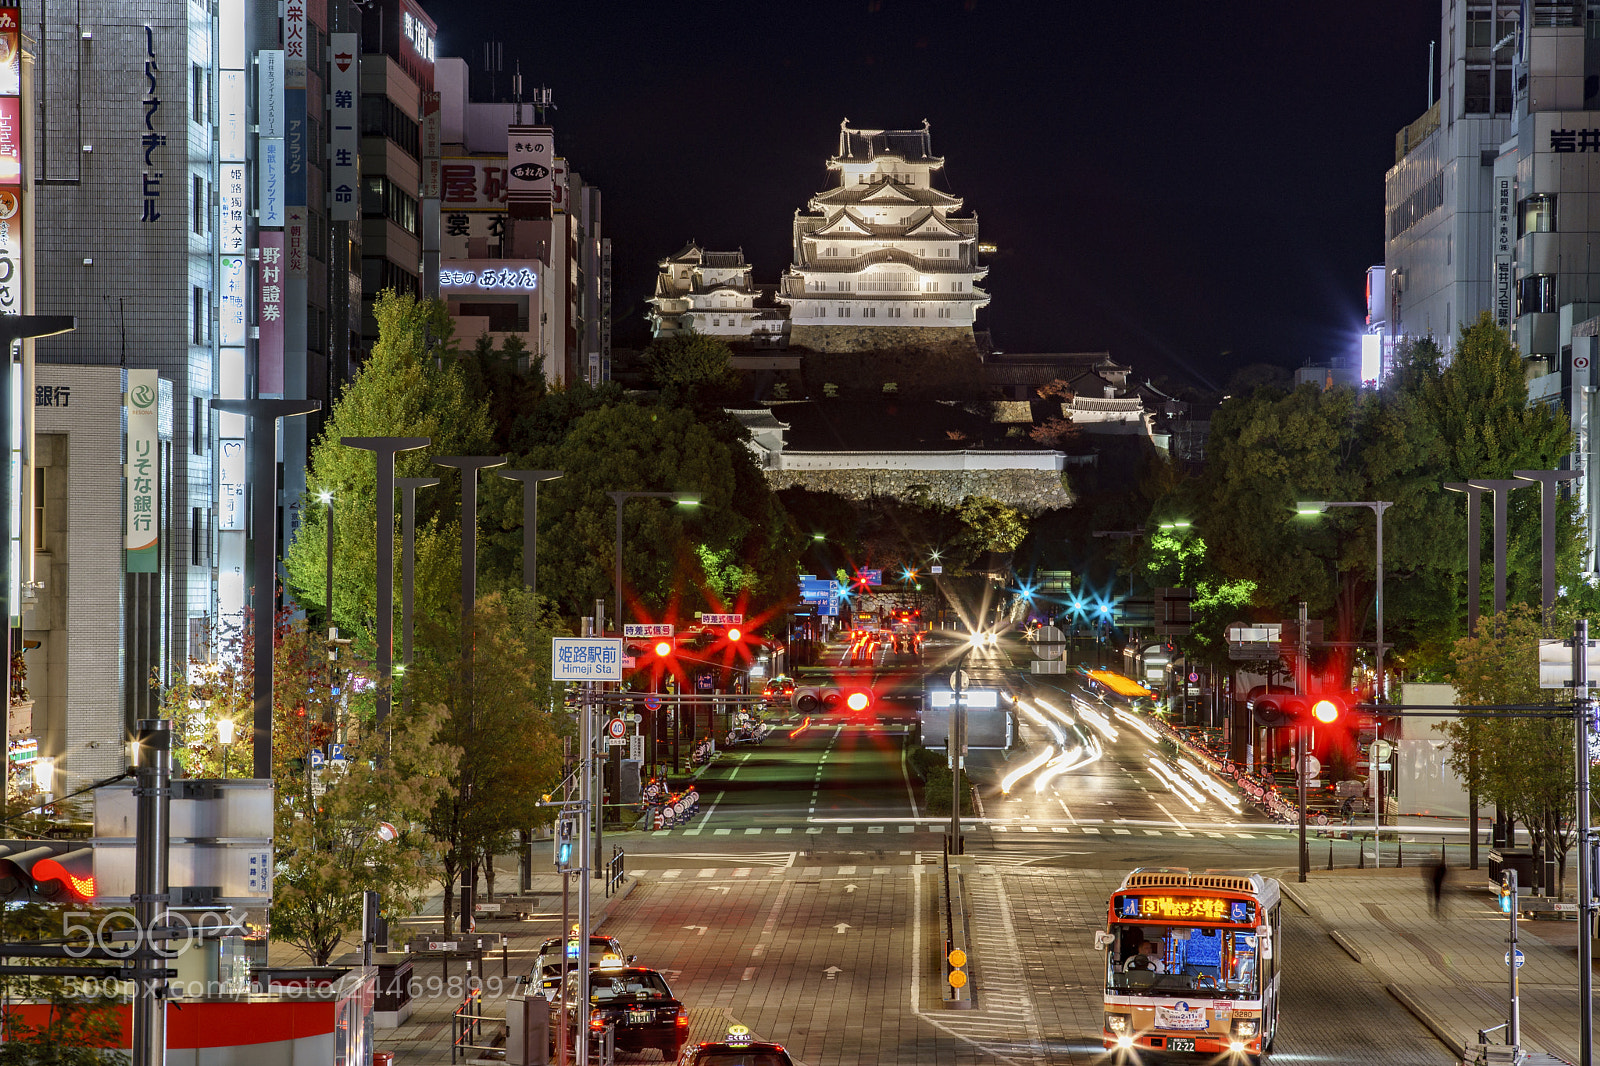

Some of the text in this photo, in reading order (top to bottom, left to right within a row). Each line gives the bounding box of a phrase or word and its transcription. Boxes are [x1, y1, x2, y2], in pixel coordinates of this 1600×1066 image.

[286, 0, 303, 57] 栄火災
[142, 25, 166, 223] しらさぎビル
[289, 119, 301, 174] アフラック
[335, 90, 352, 203] 第一生命
[515, 142, 544, 153] きもの
[1550, 129, 1600, 153] 岩井
[514, 167, 546, 178] 西松屋
[289, 225, 301, 271] 朝日火災
[262, 247, 281, 322] 野村證券
[439, 268, 537, 288] きもの 西松屋
[1498, 262, 1509, 326] 岩井コスモ証券
[35, 385, 71, 407] 銀行
[133, 439, 152, 532] りそな銀行
[703, 615, 741, 623] 時差式信号
[625, 626, 670, 635] 時差式信号
[558, 646, 616, 663] 姫路駅前
[562, 664, 615, 675] Himeji Sta.
[612, 723, 623, 733] 40
[1172, 1041, 1195, 1052] 12-22
